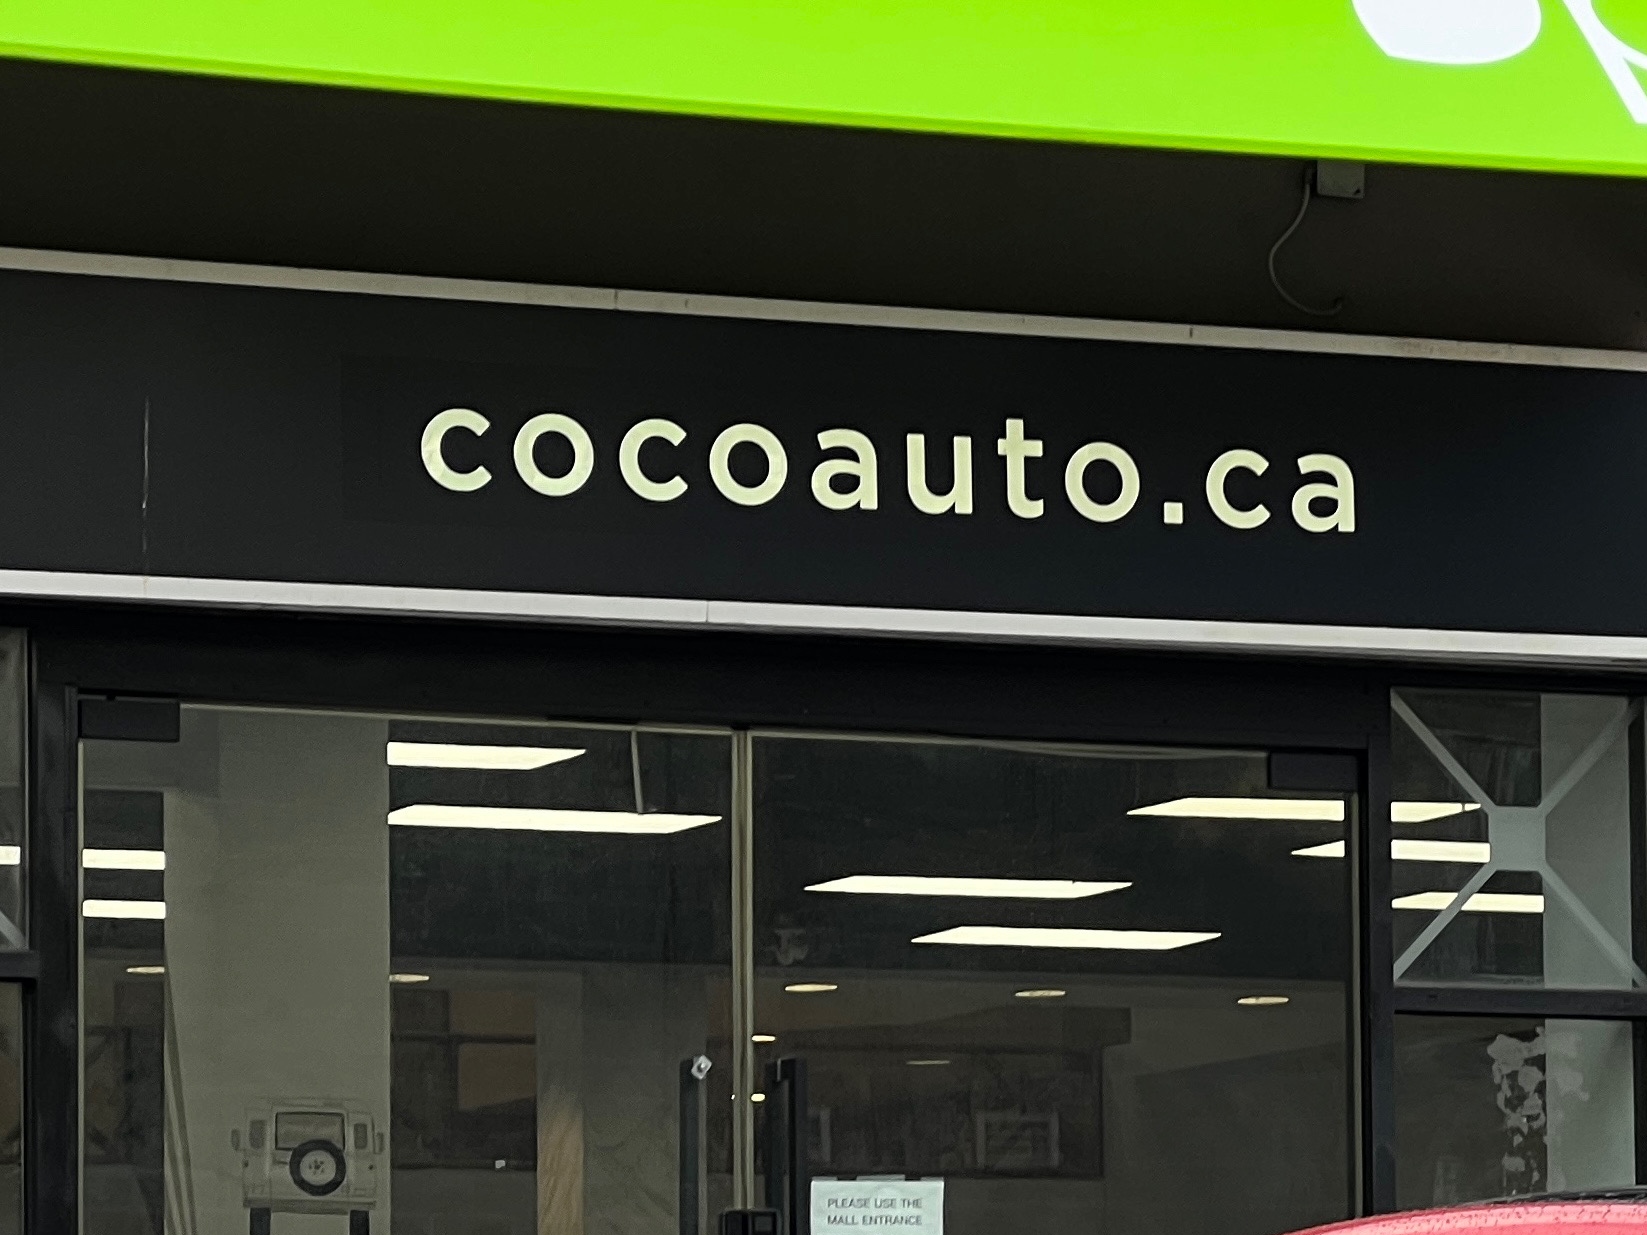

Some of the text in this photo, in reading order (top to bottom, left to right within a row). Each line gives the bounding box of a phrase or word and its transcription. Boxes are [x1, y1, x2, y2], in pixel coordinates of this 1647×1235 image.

[420, 408, 1357, 533] cocoauto.ca
[827, 1197, 923, 1209] PLEASE USE THE
[827, 1215, 923, 1226] MALL ENTRANCE
